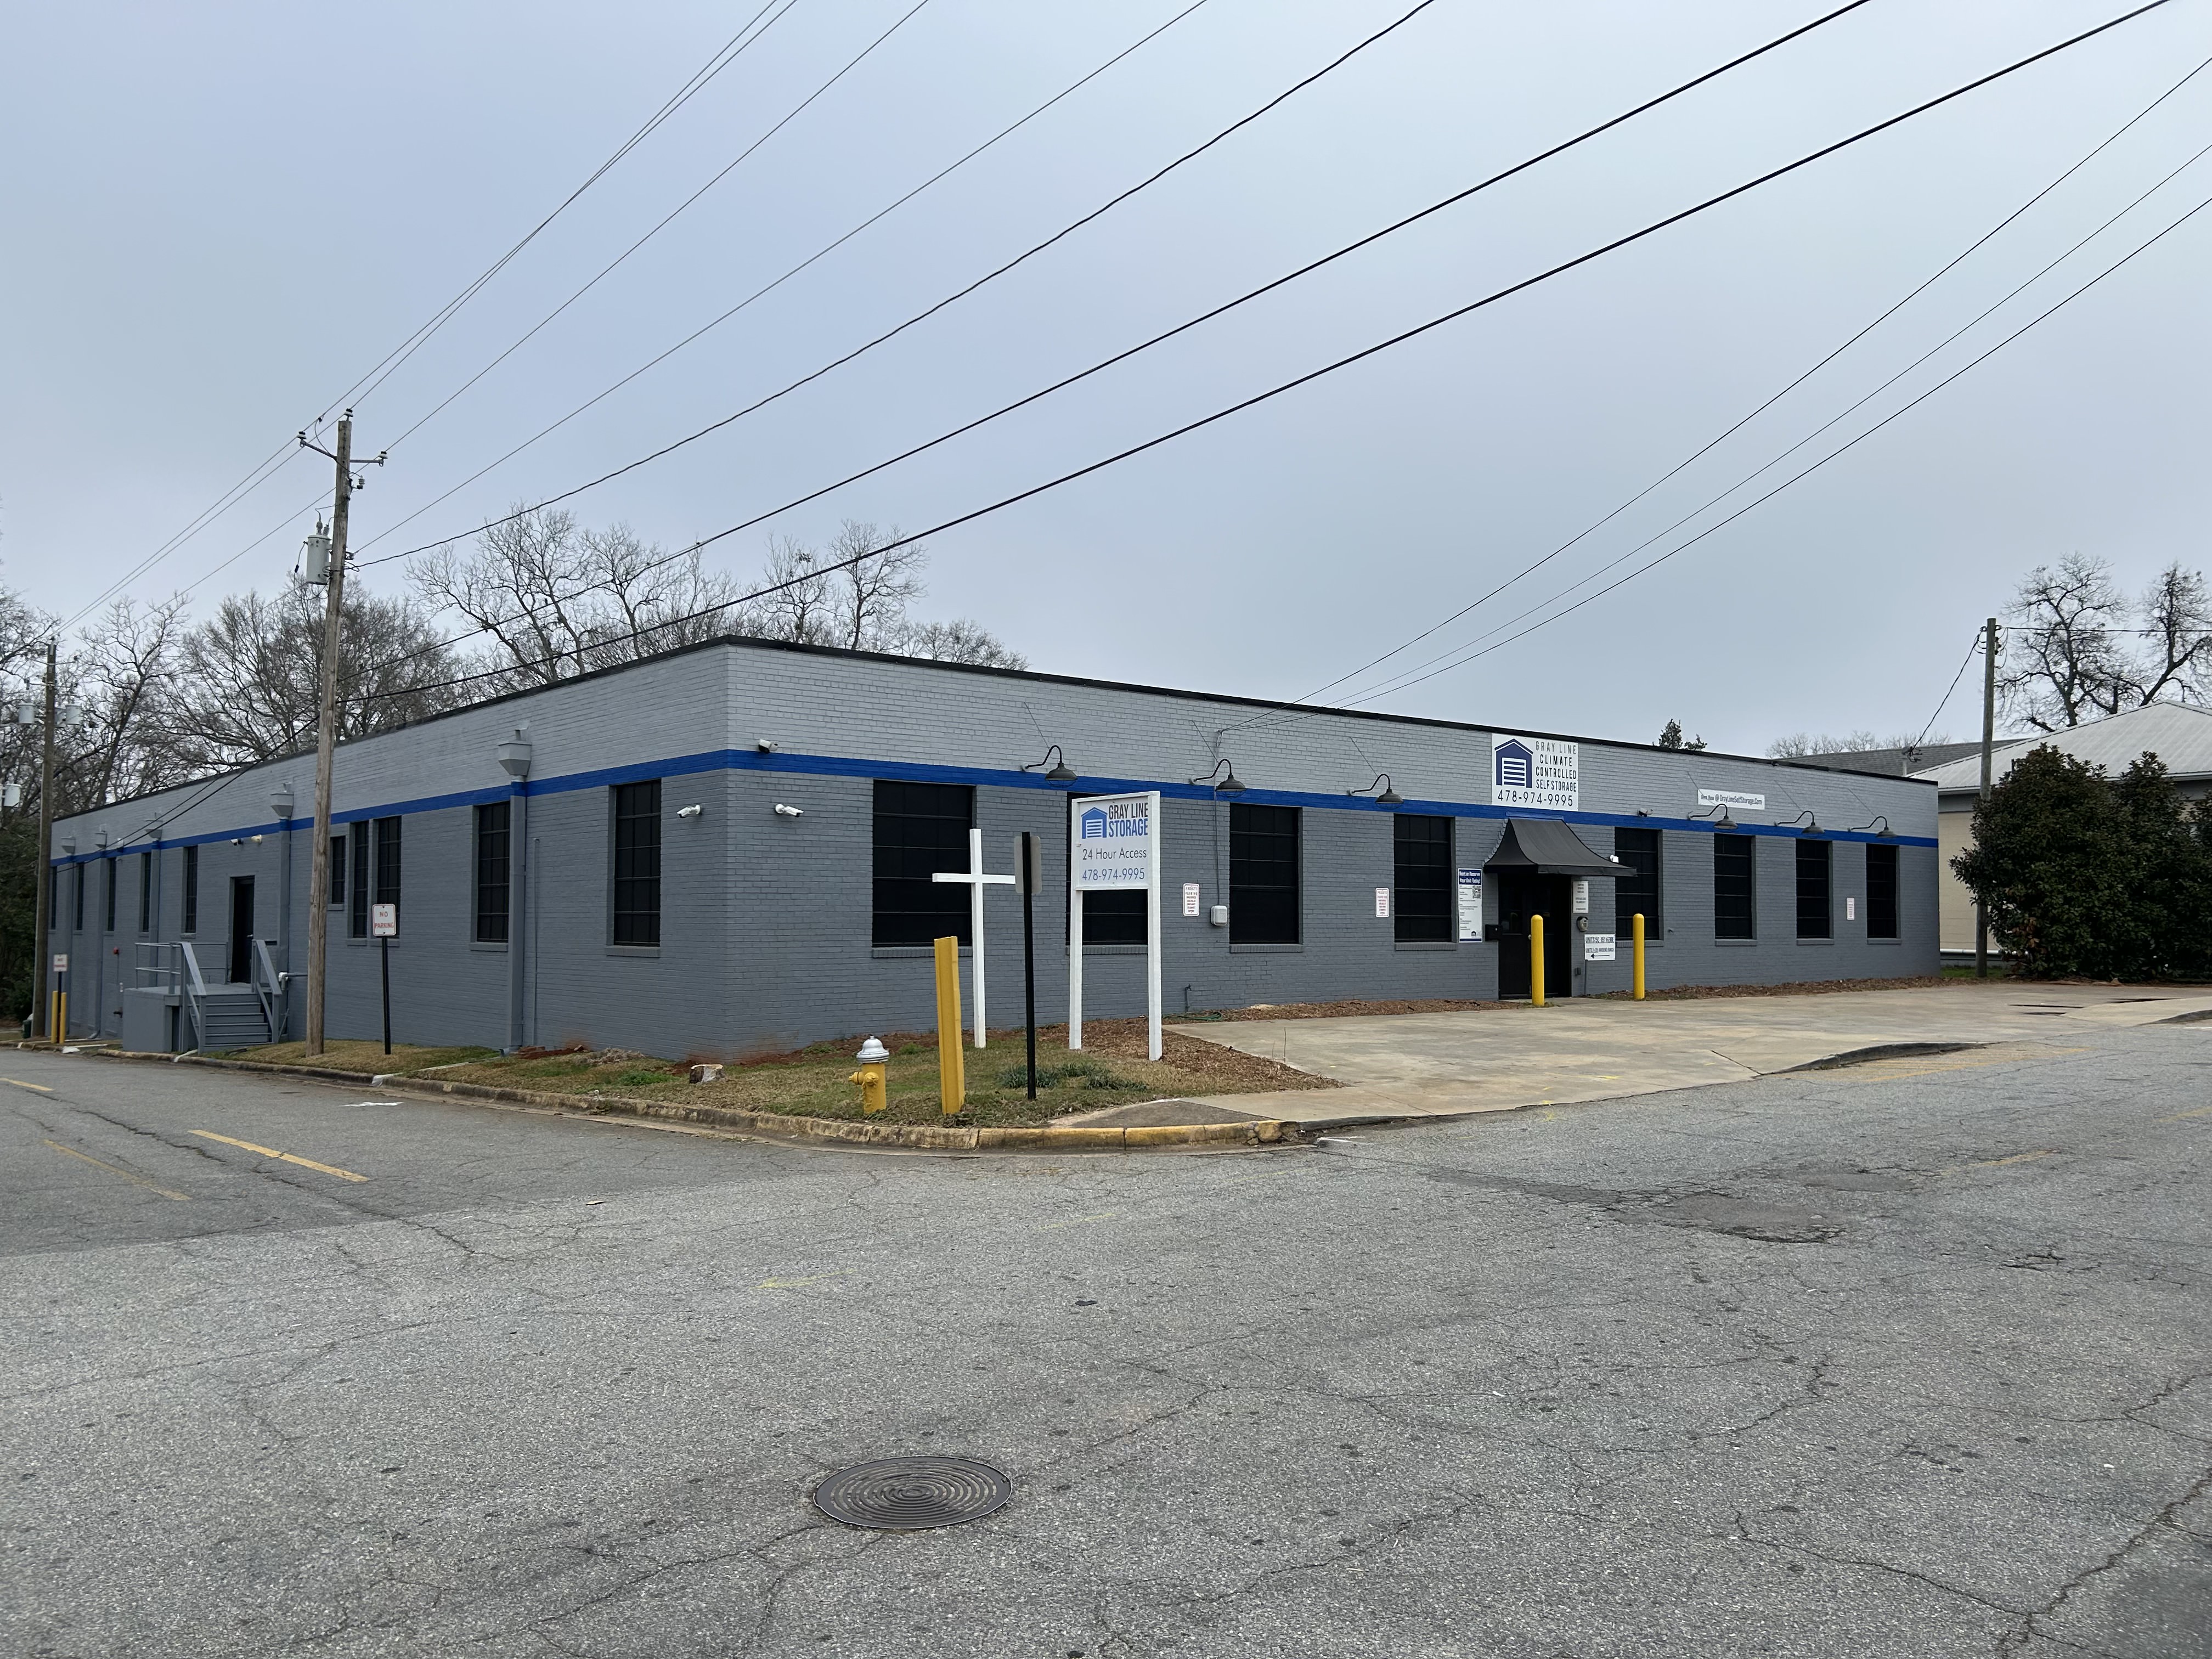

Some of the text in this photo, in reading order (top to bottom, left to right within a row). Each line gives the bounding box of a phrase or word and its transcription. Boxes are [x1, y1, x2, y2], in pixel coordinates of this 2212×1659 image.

[1536, 741, 1576, 755] GRAY LINE
[1540, 754, 1572, 767] CLIMATE
[1536, 766, 1576, 780] CONTROLLED
[1536, 779, 1577, 792] SELF STORAGE
[1498, 789, 1573, 806] 478-974-9995
[1109, 802, 1148, 820] GRAY LINE
[1109, 818, 1148, 838] STORAGE
[1082, 847, 1147, 860] 24 Hour Access
[1082, 867, 1145, 881] 478-974-9995
